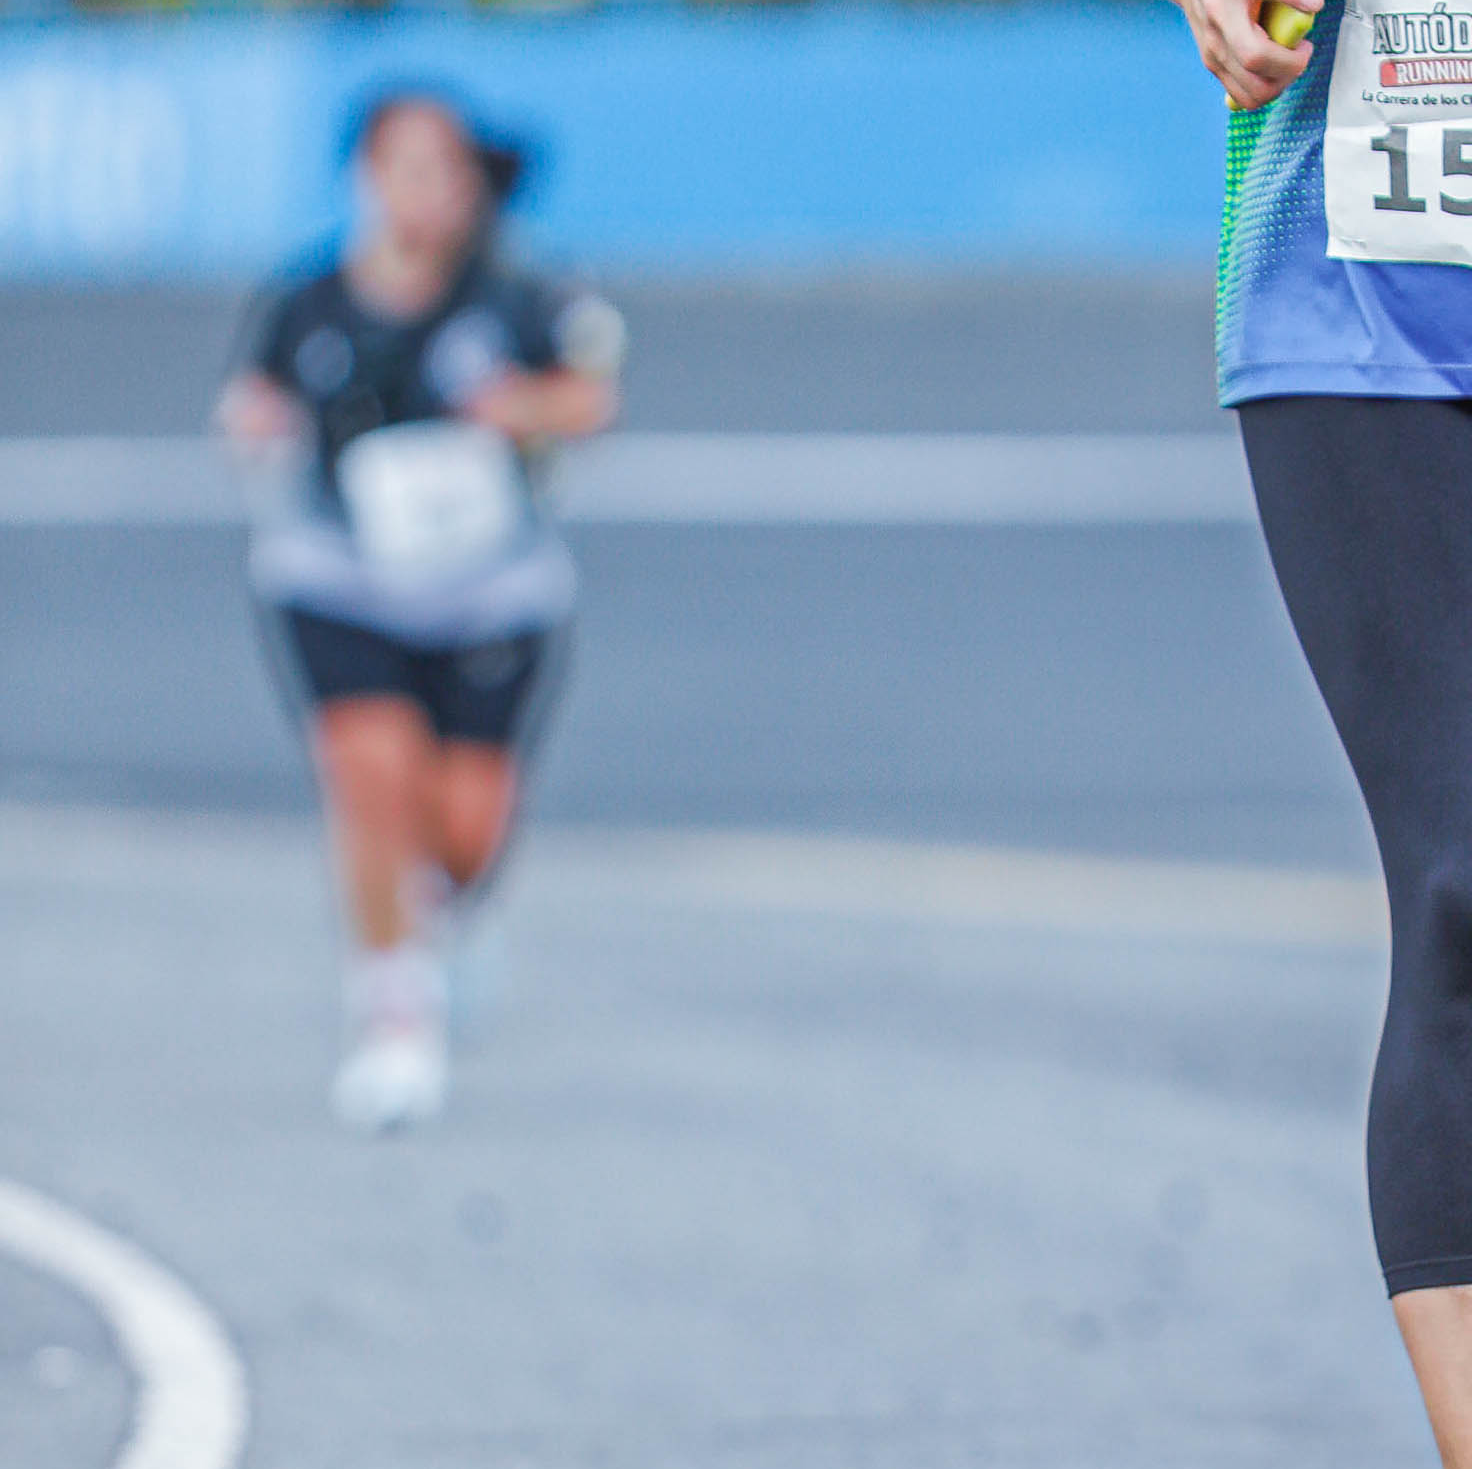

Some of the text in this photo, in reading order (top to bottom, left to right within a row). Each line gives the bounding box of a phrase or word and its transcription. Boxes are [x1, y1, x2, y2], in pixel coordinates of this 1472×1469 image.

[1362, 89, 1374, 102] La
[1376, 91, 1418, 105] Carrera
[1422, 93, 1438, 106] de
[1440, 93, 1459, 106] los
